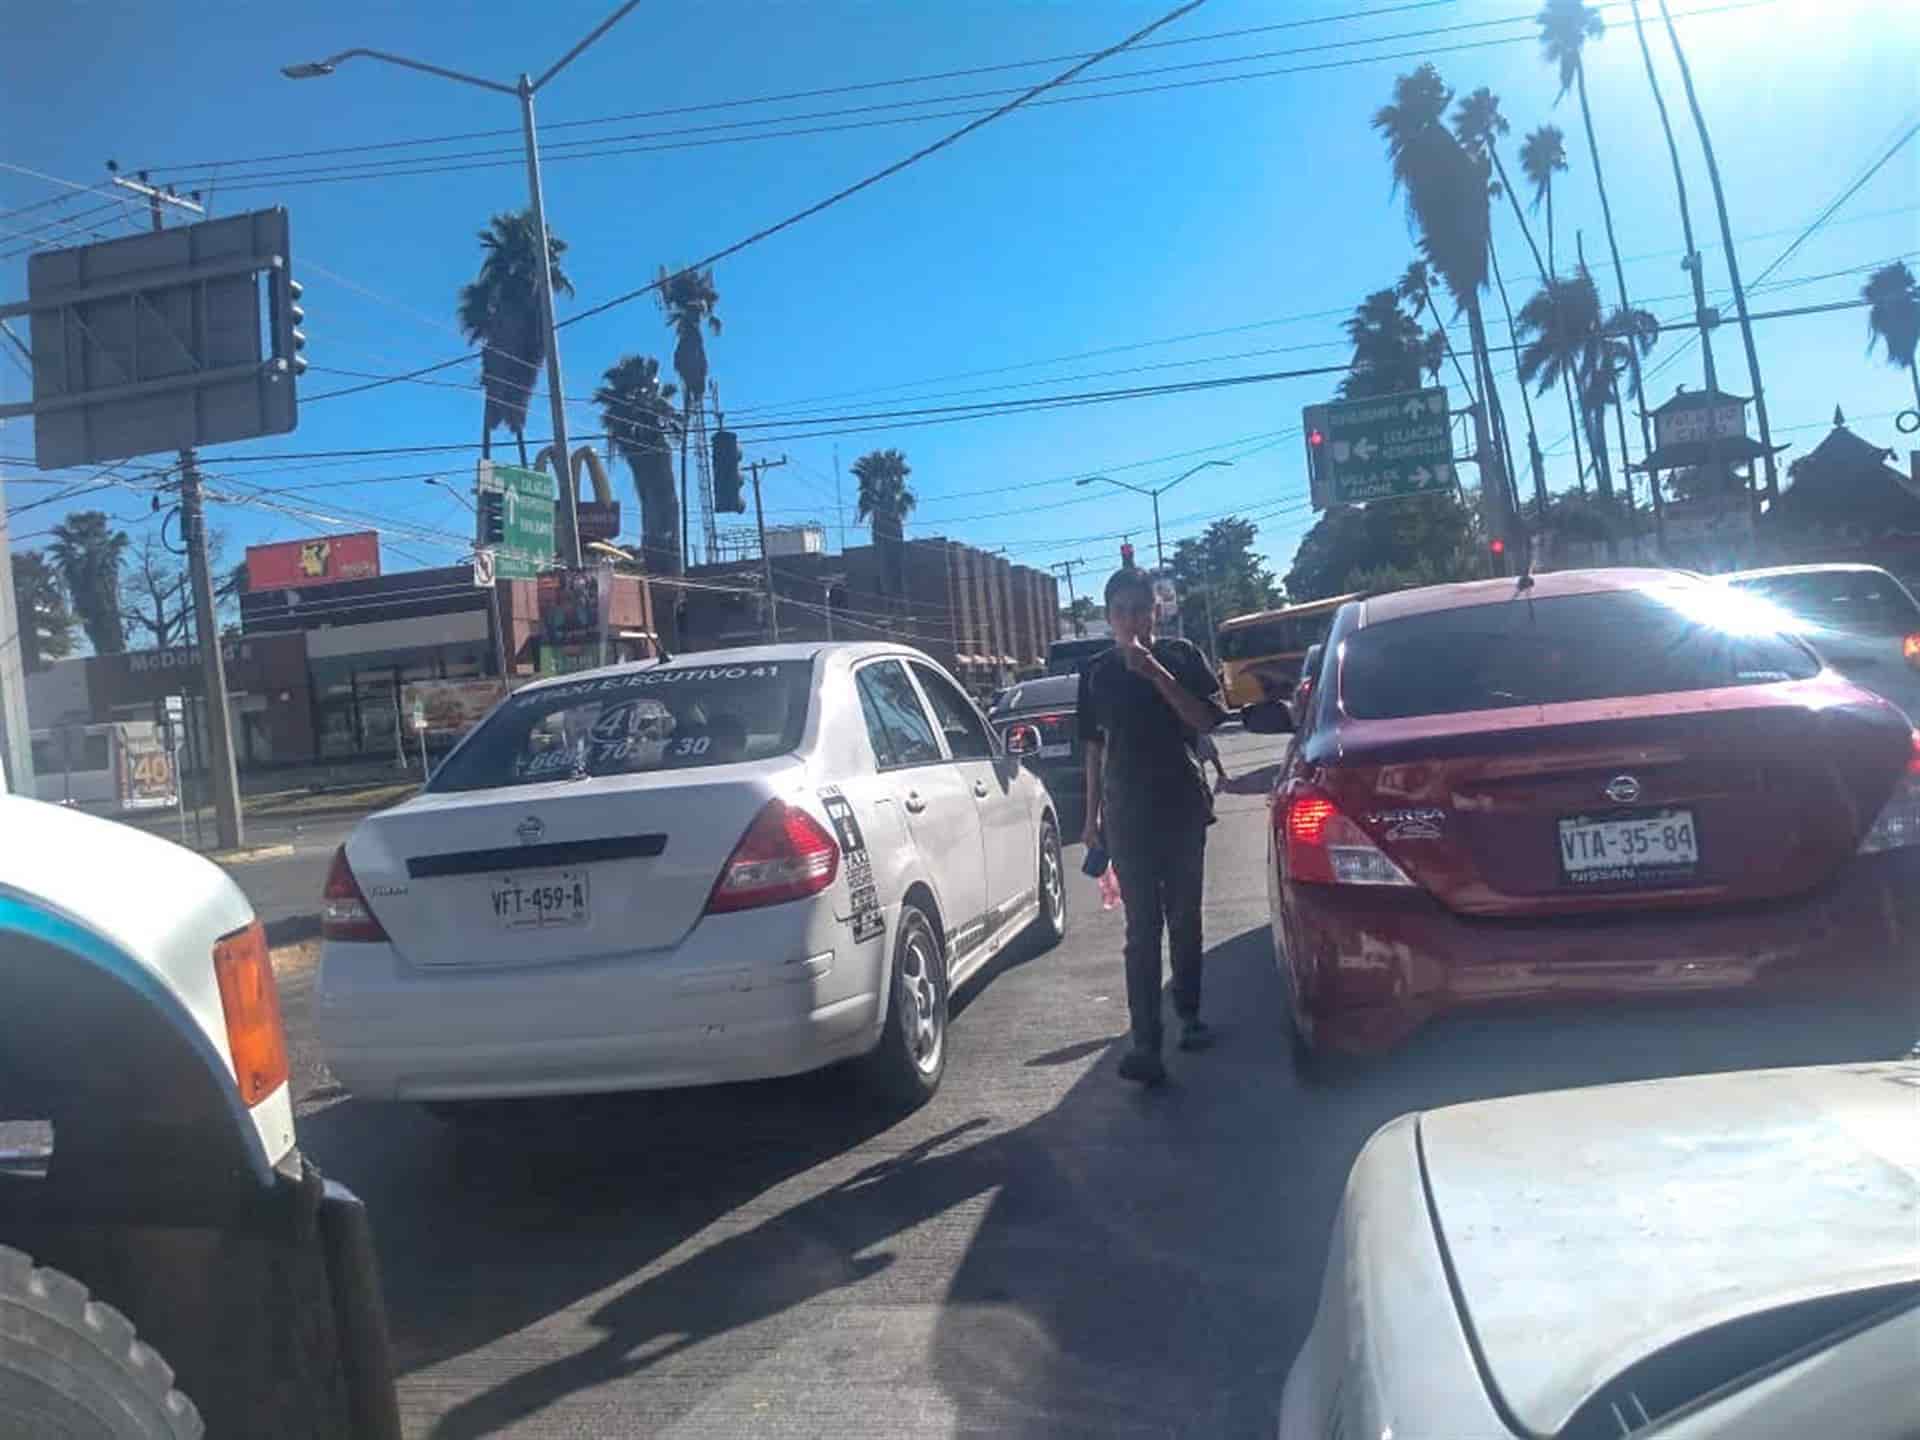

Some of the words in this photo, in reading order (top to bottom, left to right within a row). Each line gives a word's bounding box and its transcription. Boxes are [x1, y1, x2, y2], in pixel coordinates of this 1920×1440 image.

[599, 666, 746, 690] EJECUTIVO
[1561, 823, 1693, 861] VTA-35-84
[491, 884, 585, 915] VFT-459-A
